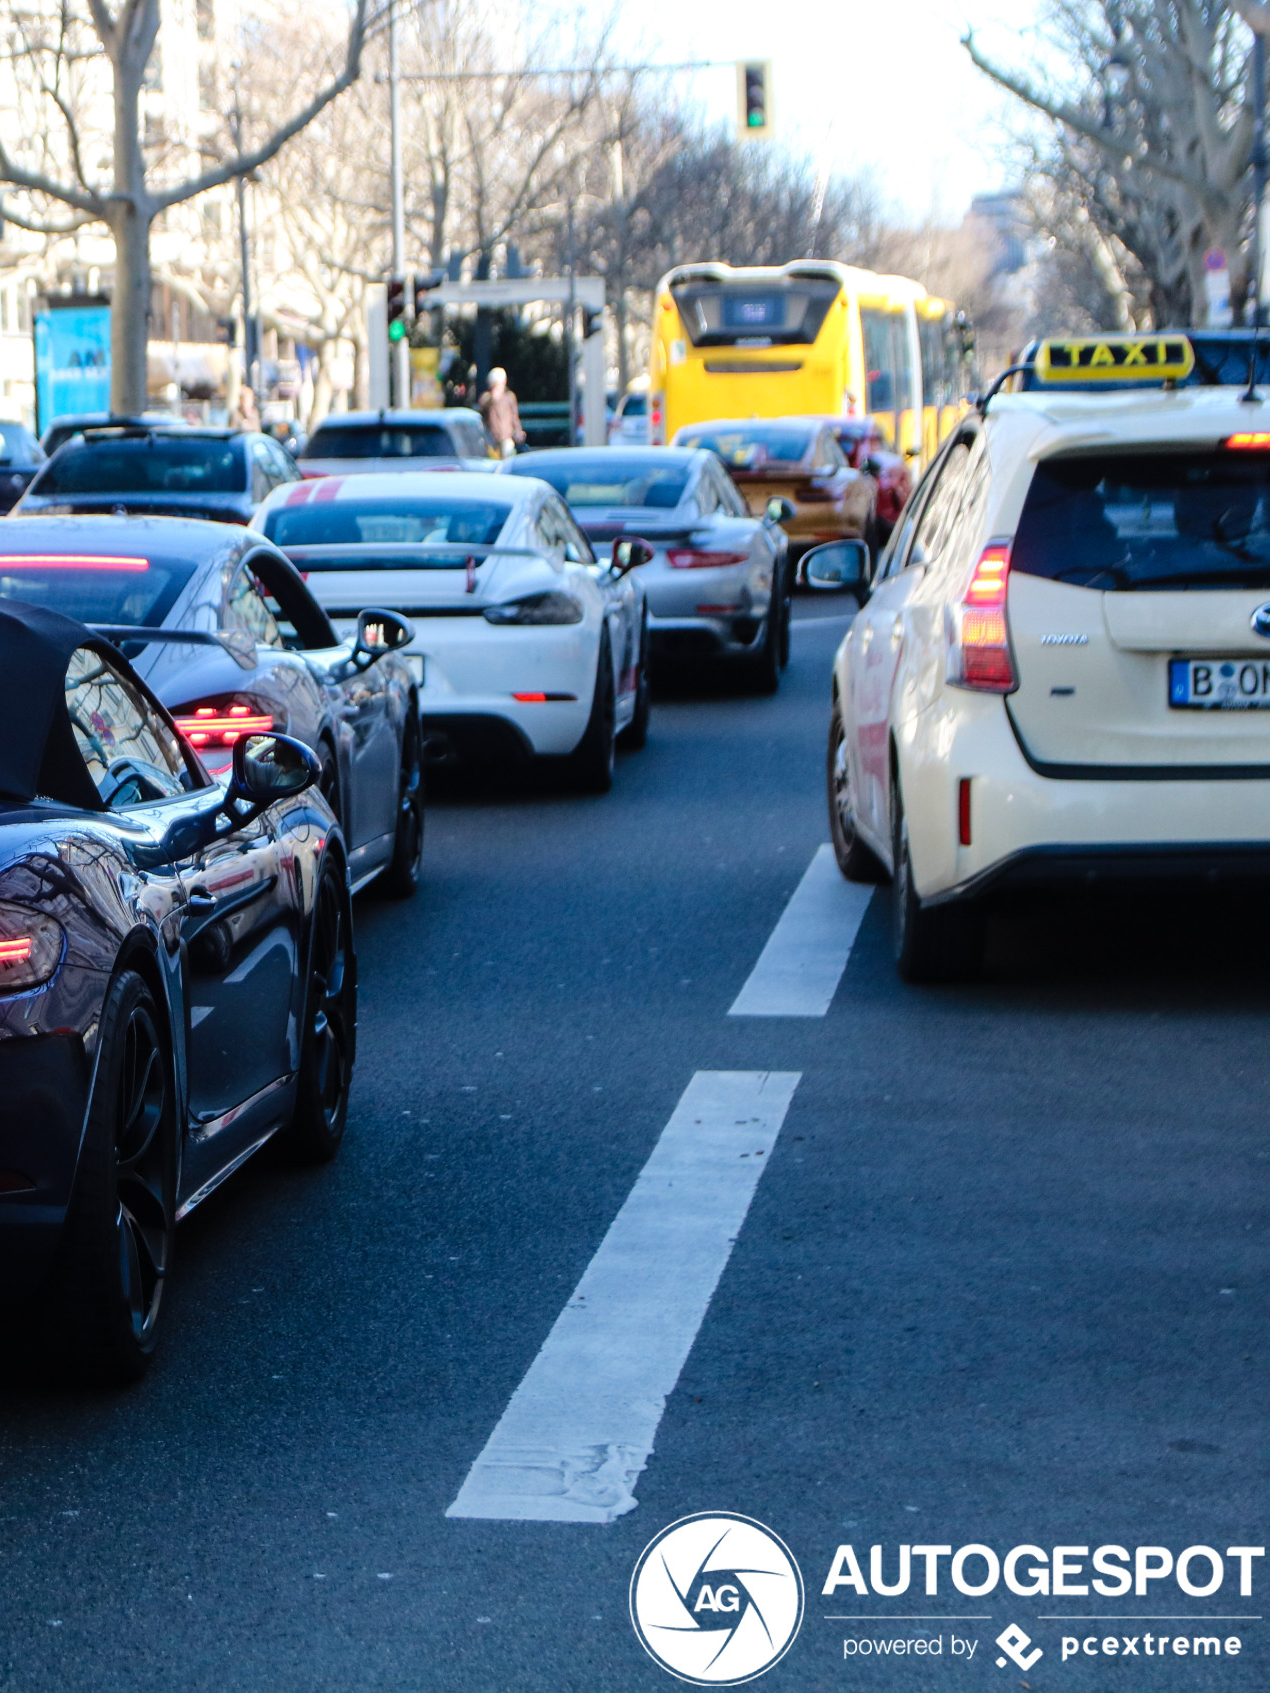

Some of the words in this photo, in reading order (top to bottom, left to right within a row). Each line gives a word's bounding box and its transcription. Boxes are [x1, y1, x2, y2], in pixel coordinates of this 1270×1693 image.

[1064, 342, 1167, 367] TAXI
[1040, 633, 1089, 645] TOYOTA
[1193, 666, 1213, 695] B
